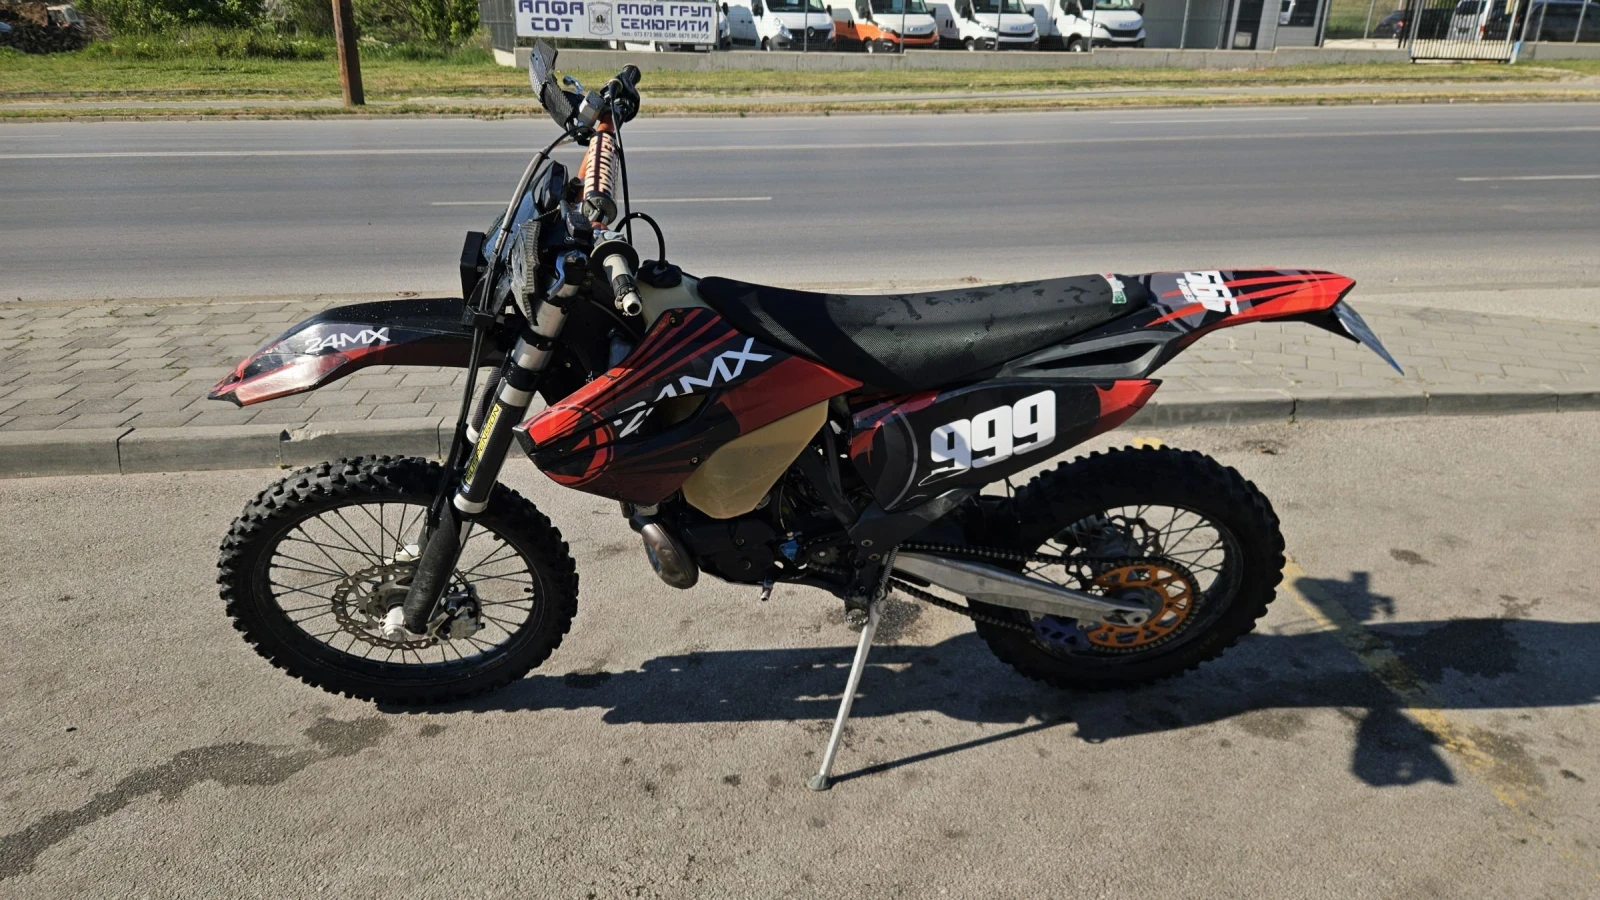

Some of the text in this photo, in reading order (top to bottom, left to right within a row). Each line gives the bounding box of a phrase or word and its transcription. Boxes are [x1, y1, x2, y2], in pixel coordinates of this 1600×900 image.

[669, 5, 712, 18] ГРУП
[530, 17, 574, 33] СОТ
[620, 18, 709, 33] СЕКЮРИТИ
[304, 326, 391, 354] 24MX
[930, 389, 1056, 475] 999
[466, 404, 501, 483] SUSPENSION
